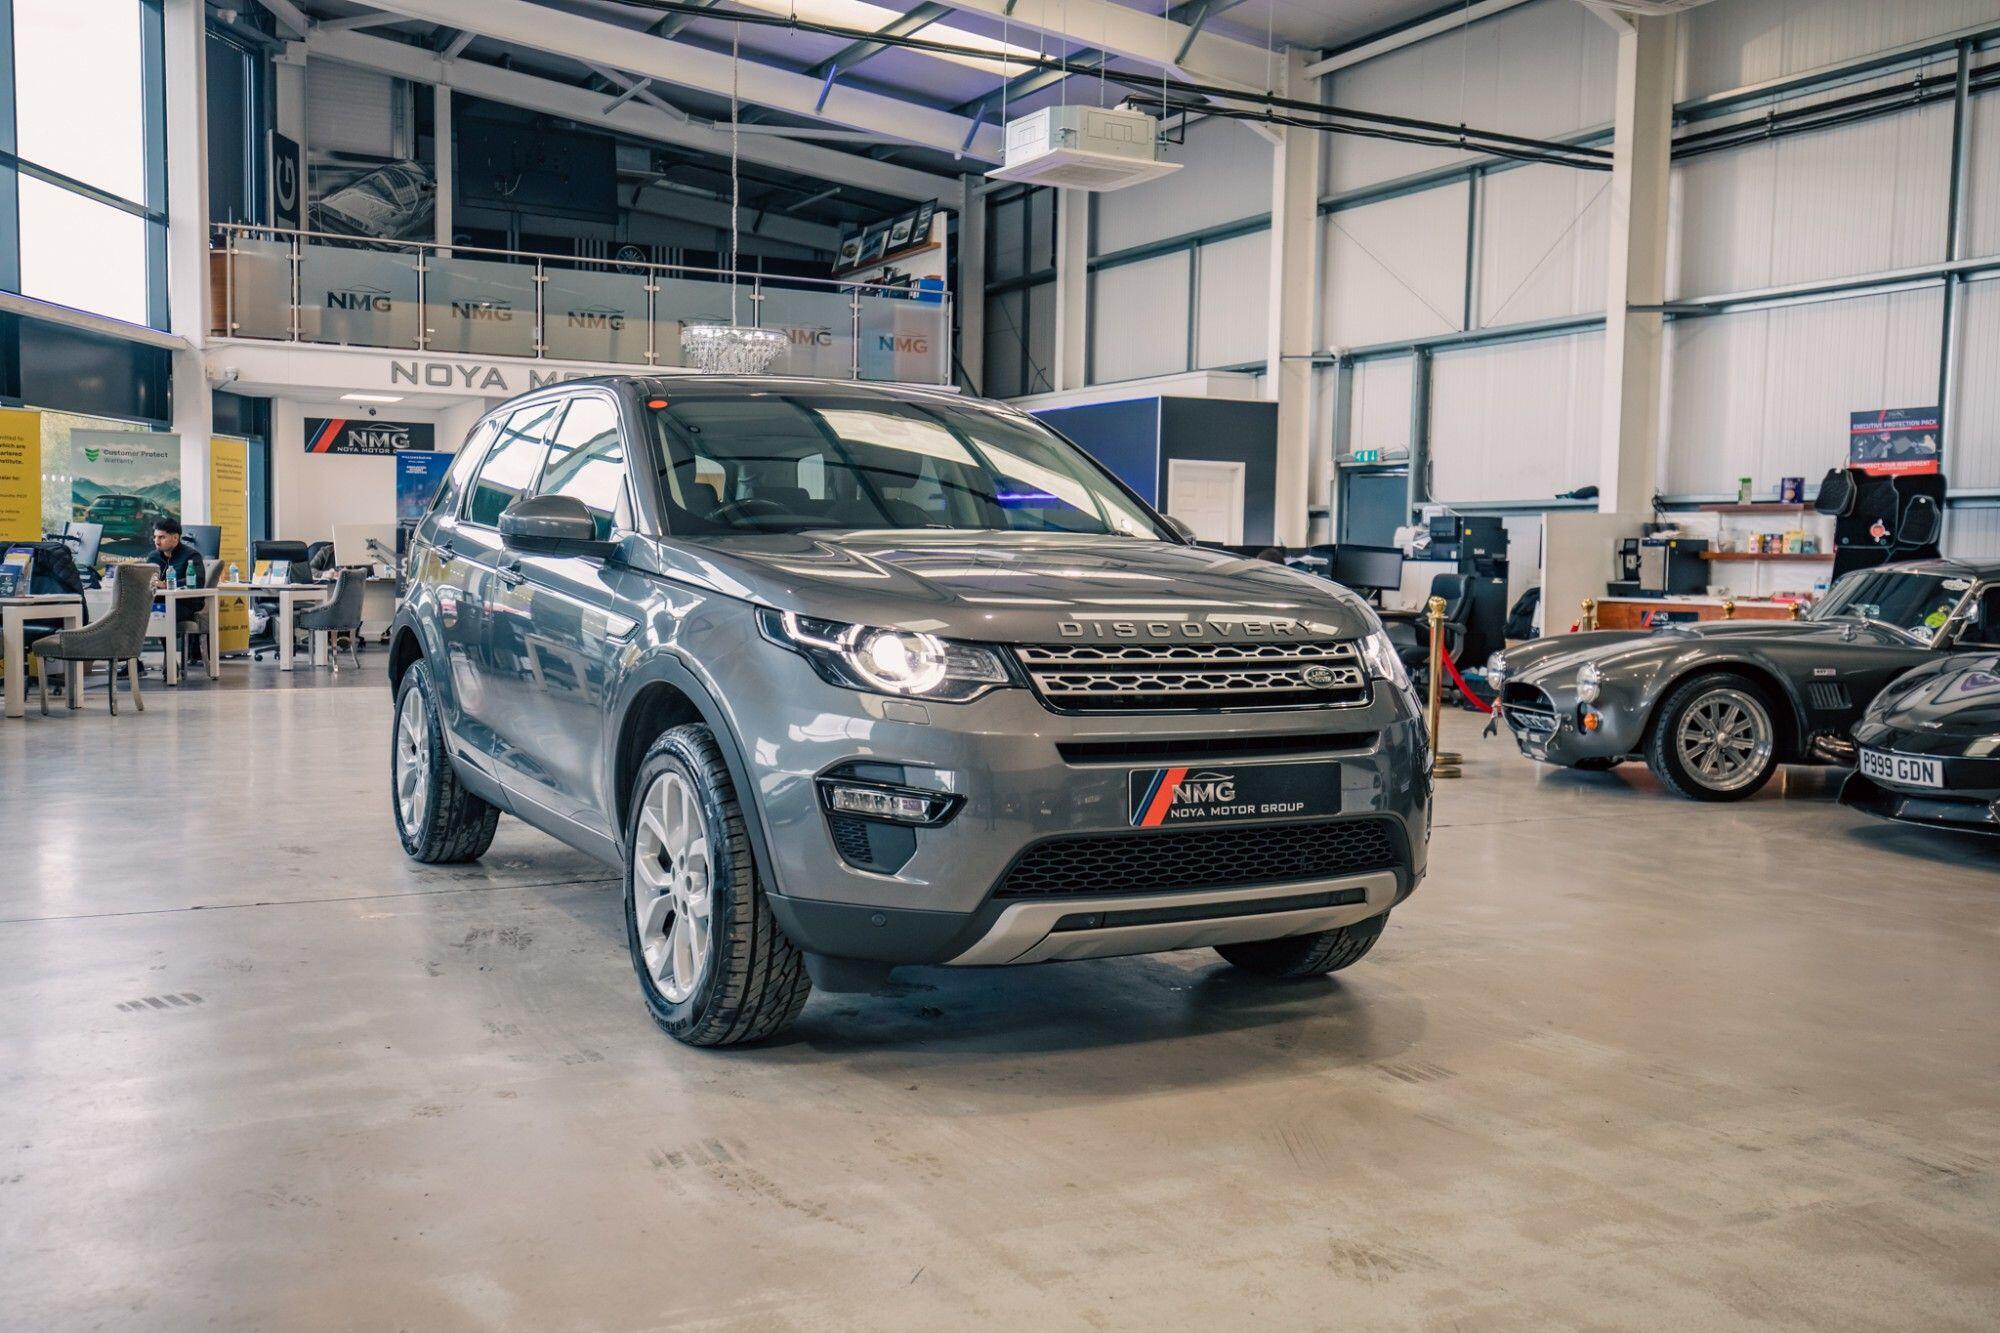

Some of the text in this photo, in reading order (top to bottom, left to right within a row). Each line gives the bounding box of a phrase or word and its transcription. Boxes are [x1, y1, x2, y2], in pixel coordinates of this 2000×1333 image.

[327, 291, 391, 313] NMG
[451, 302, 512, 322] NMG
[568, 311, 625, 331] NMG
[878, 335, 928, 354] NMG
[391, 360, 508, 391] NOYA
[348, 430, 410, 449] NMG
[103, 449, 168, 458] Customer Protect
[104, 457, 134, 465] Warranty
[100, 555, 148, 563] Comprehens
[1057, 621, 1313, 638] DISCOVERY
[1863, 752, 1935, 783] P999 GDN
[1170, 782, 1236, 804] NMG
[1170, 802, 1305, 819] NOYA MOTOR GROUP
